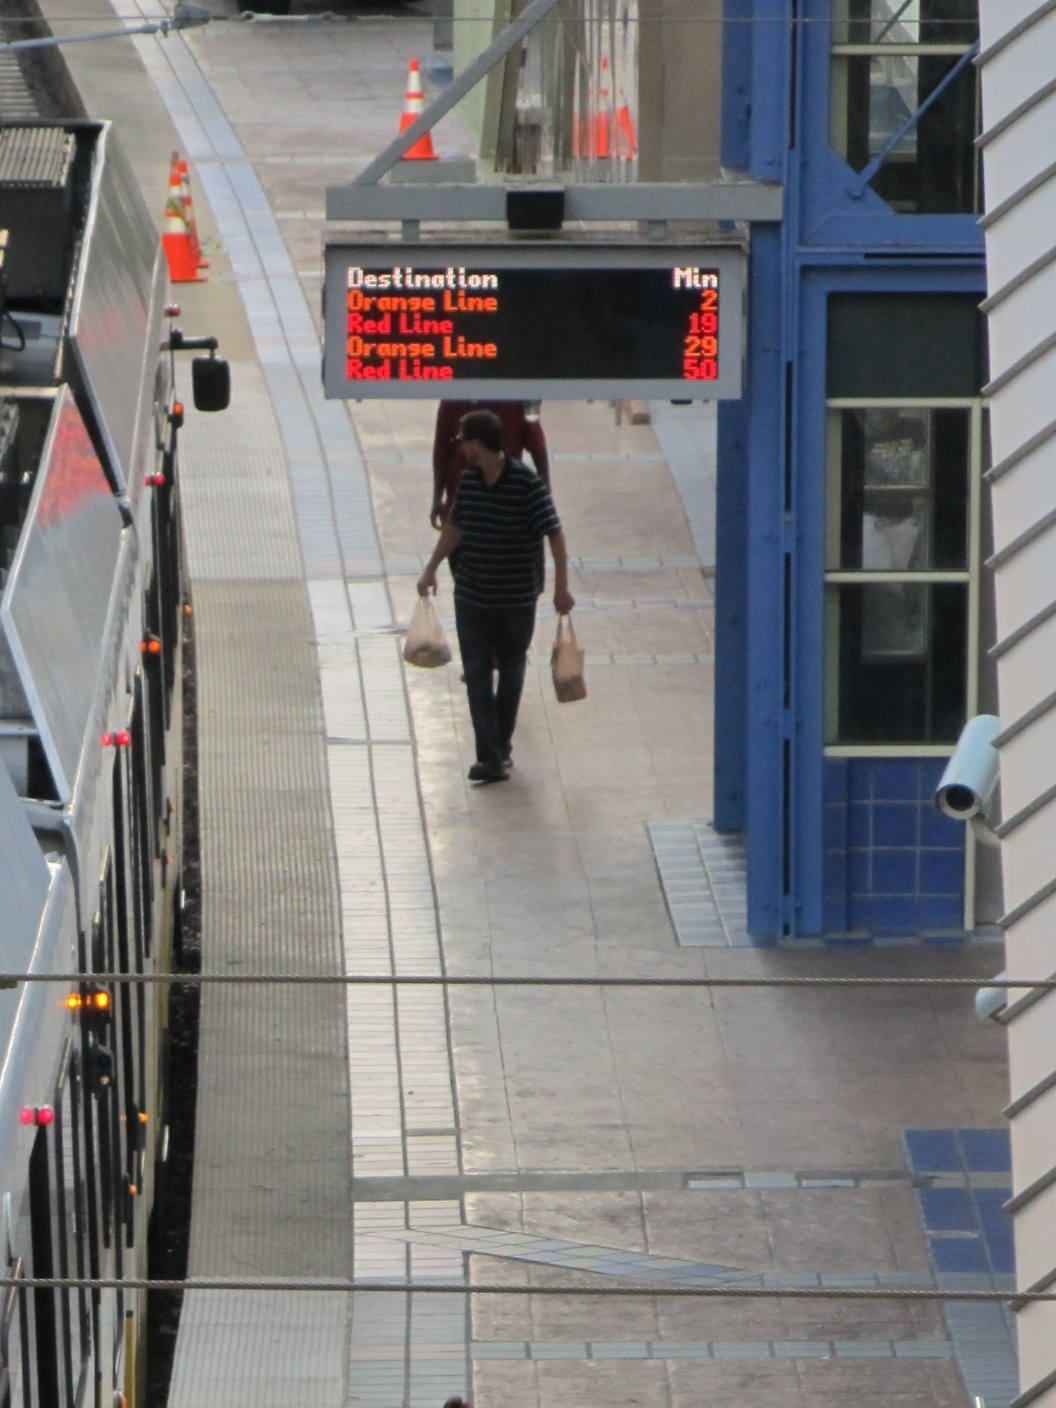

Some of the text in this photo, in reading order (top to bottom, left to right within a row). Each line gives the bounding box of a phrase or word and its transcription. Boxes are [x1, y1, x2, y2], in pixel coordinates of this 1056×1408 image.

[347, 267, 718, 288] Destination Min
[347, 290, 718, 312] Orange Line 2
[347, 313, 717, 335] Red Line 19
[347, 336, 718, 358] Orange Line 29
[347, 359, 717, 381] Red Line 50
